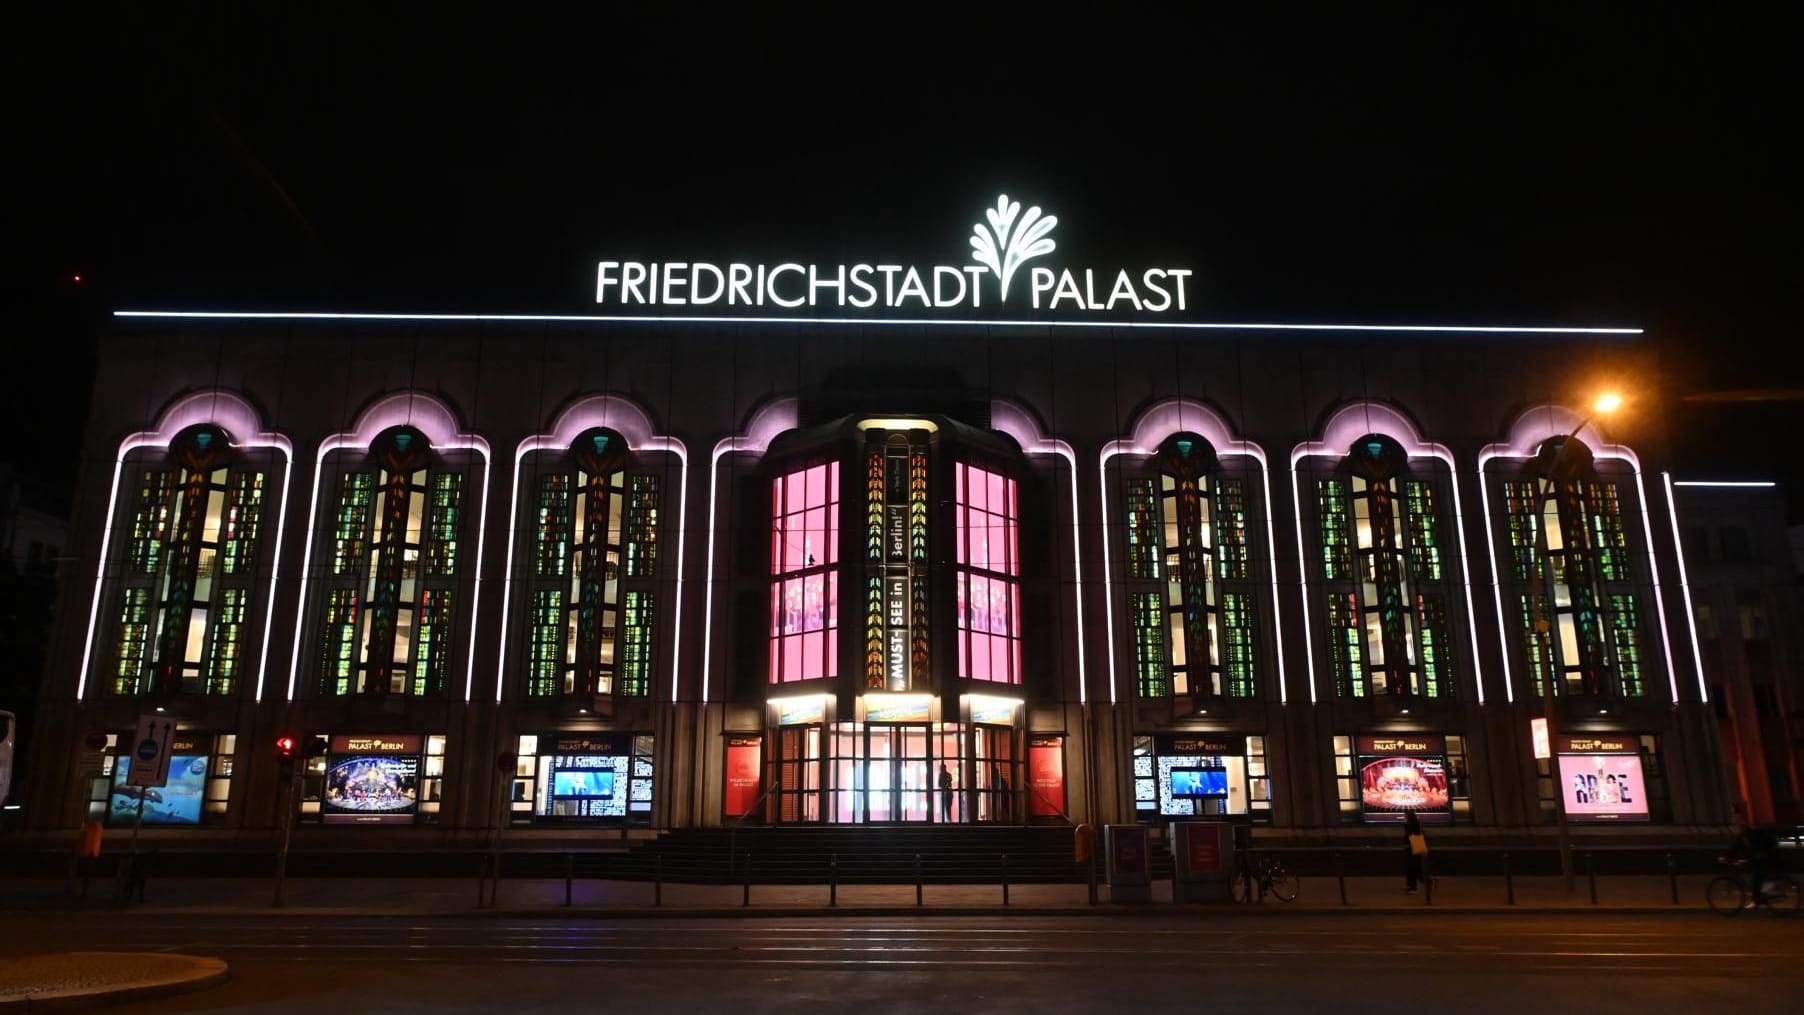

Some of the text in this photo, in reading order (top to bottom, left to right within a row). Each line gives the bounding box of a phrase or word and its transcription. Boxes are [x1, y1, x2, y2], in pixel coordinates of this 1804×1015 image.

[596, 261, 1192, 311] FRIEDRICHSTADT PALAST
[889, 582, 903, 596] in
[891, 601, 903, 626] SEE
[348, 742, 373, 750] PALAST
[559, 743, 612, 751] PALAST BERLIN
[1174, 743, 1226, 751] PALAST BERLIN
[1374, 743, 1427, 751] PALAST BERLIN
